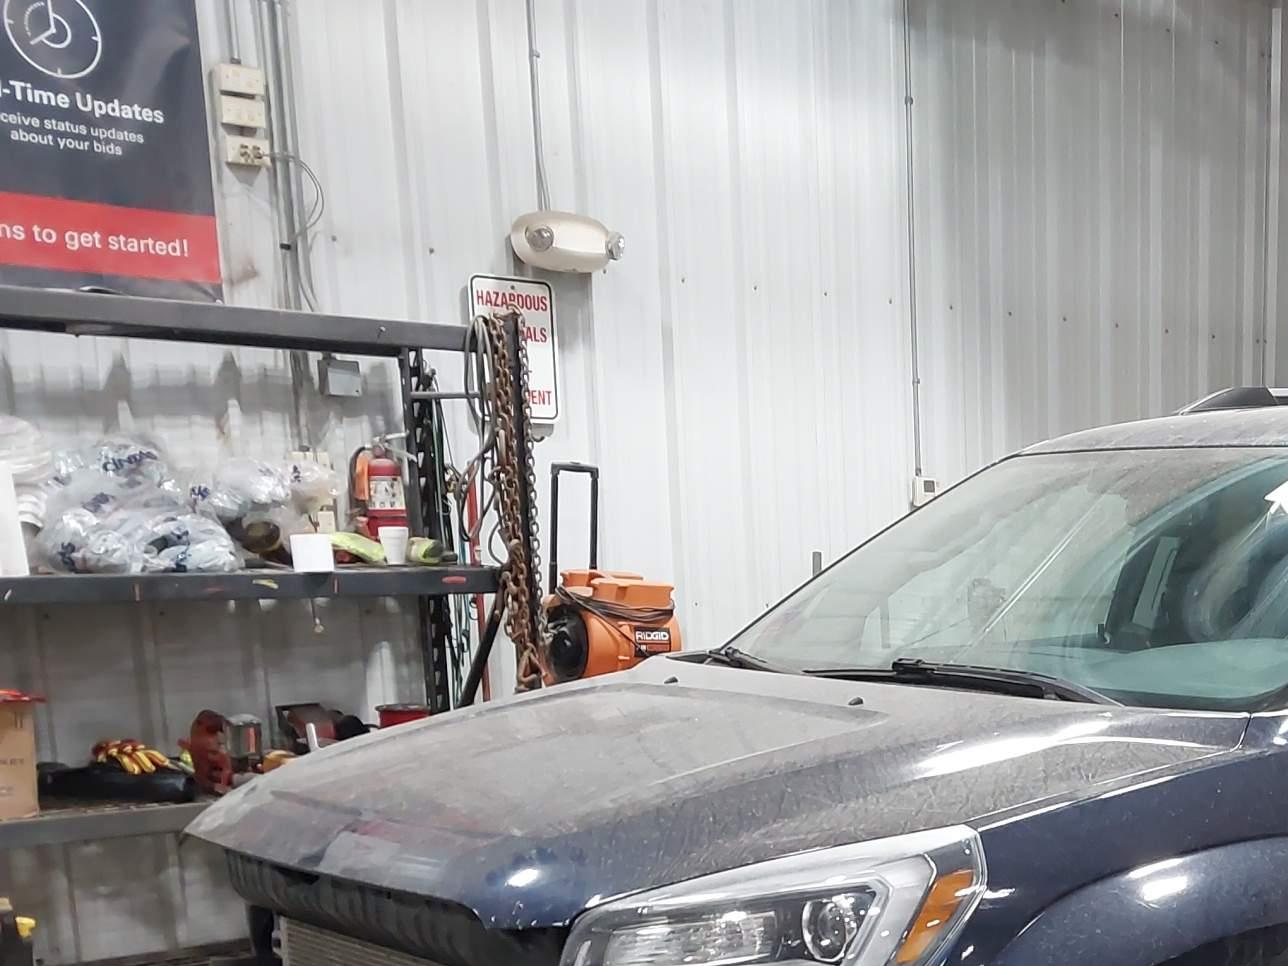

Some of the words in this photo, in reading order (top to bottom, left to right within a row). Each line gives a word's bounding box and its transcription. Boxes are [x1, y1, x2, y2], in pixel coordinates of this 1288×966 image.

[75, 92, 165, 124] Updates
[10, 128, 54, 145] about
[57, 136, 90, 151] your
[93, 140, 122, 156] bids
[43, 118, 88, 135] status
[90, 126, 144, 144] updates
[32, 224, 57, 244] to
[64, 230, 102, 250] get
[107, 234, 188, 257] started!
[476, 289, 548, 312] HAZARDOUS
[635, 631, 669, 641] RIDGID
